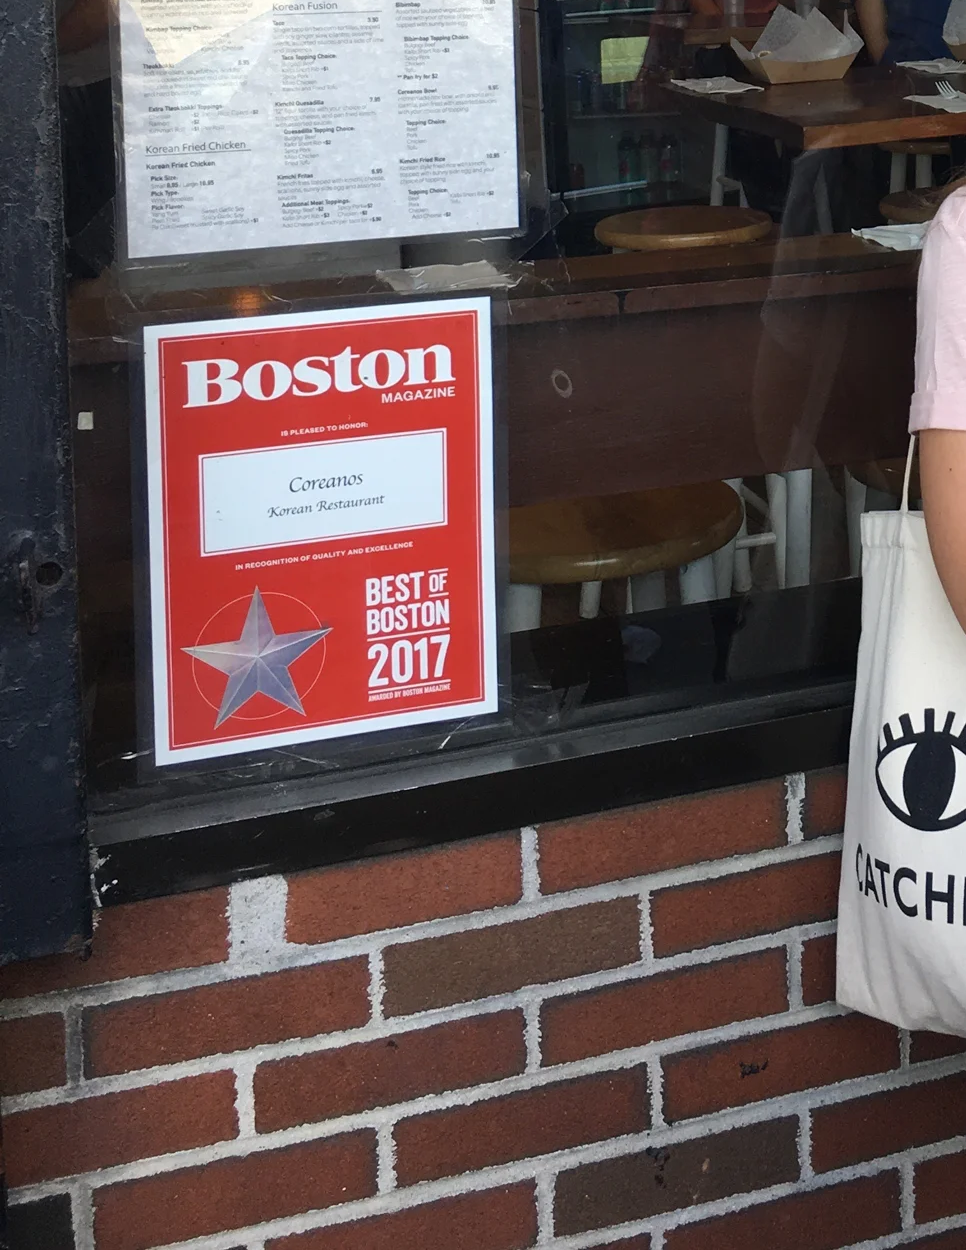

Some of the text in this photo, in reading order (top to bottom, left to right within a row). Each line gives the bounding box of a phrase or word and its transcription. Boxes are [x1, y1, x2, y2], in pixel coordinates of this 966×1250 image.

[273, 1, 338, 11] Korean Fusion
[146, 141, 246, 154] Korean Fried Chicken
[181, 344, 456, 408] Boston
[382, 386, 455, 404] MAGAZINE
[280, 421, 368, 437] IS PLEASED TO HONOR:
[289, 473, 364, 493] Coreanos
[267, 494, 385, 518] Korean Restaurant
[244, 556, 299, 569] RECOGNITION
[300, 554, 311, 562] OF
[312, 550, 346, 561] QUALITY
[347, 547, 364, 555] AND
[365, 541, 413, 554] EXCELLENCE
[365, 571, 447, 606] BEST OF
[366, 599, 450, 635] BOSTON
[368, 634, 450, 687] 2017
[368, 683, 451, 702] AWARDED BY BOSTON MAGAZINE
